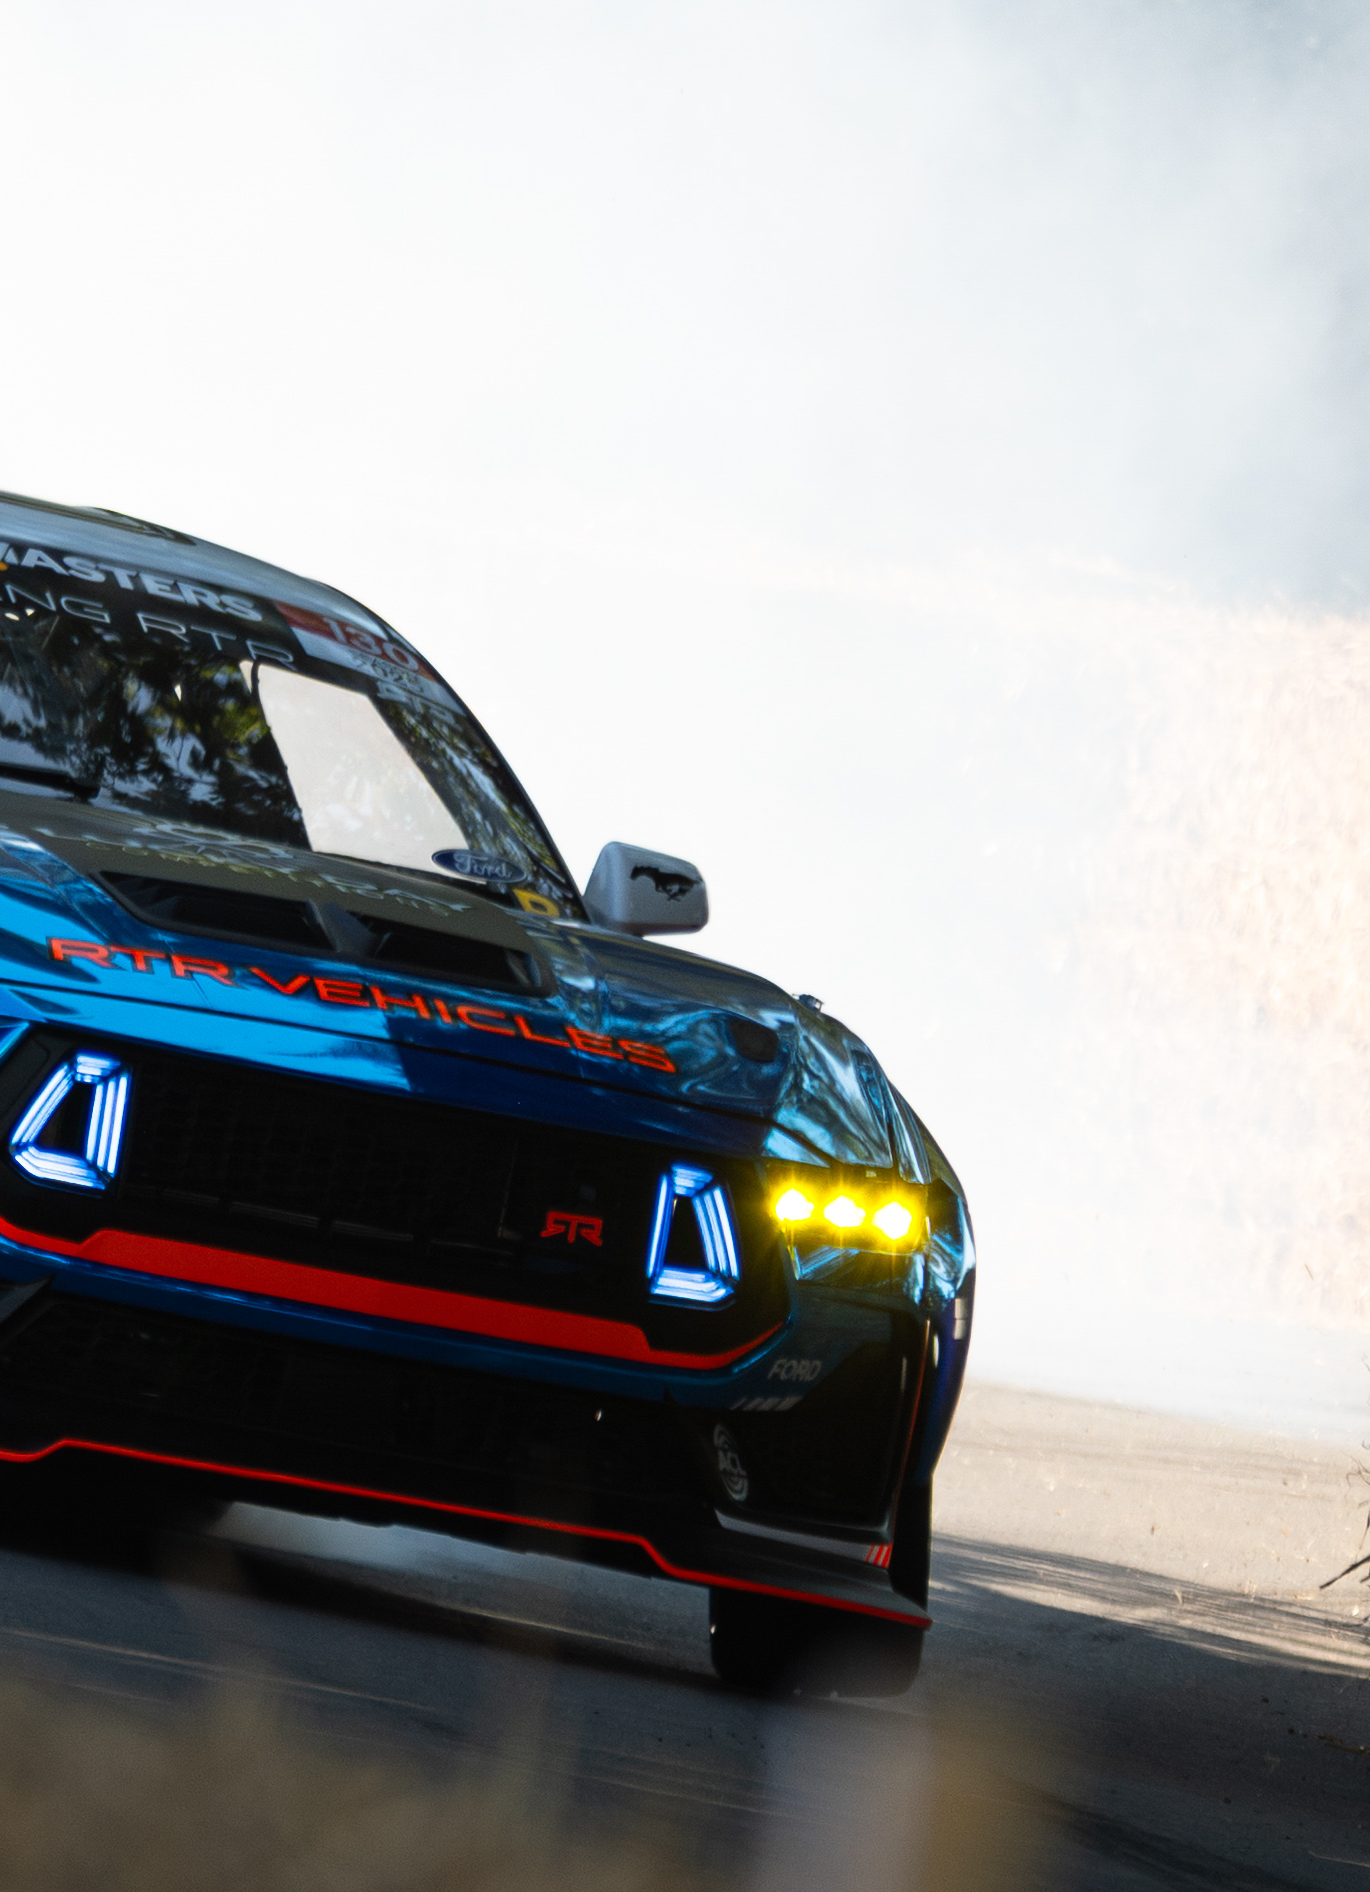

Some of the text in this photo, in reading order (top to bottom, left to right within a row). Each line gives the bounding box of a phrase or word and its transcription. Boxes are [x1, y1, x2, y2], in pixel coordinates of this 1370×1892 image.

[46, 935, 679, 1074] RTR VEHICLES
[540, 1210, 604, 1247] RTR
[766, 1358, 823, 1383] FORD
[716, 1449, 748, 1478] ACL
